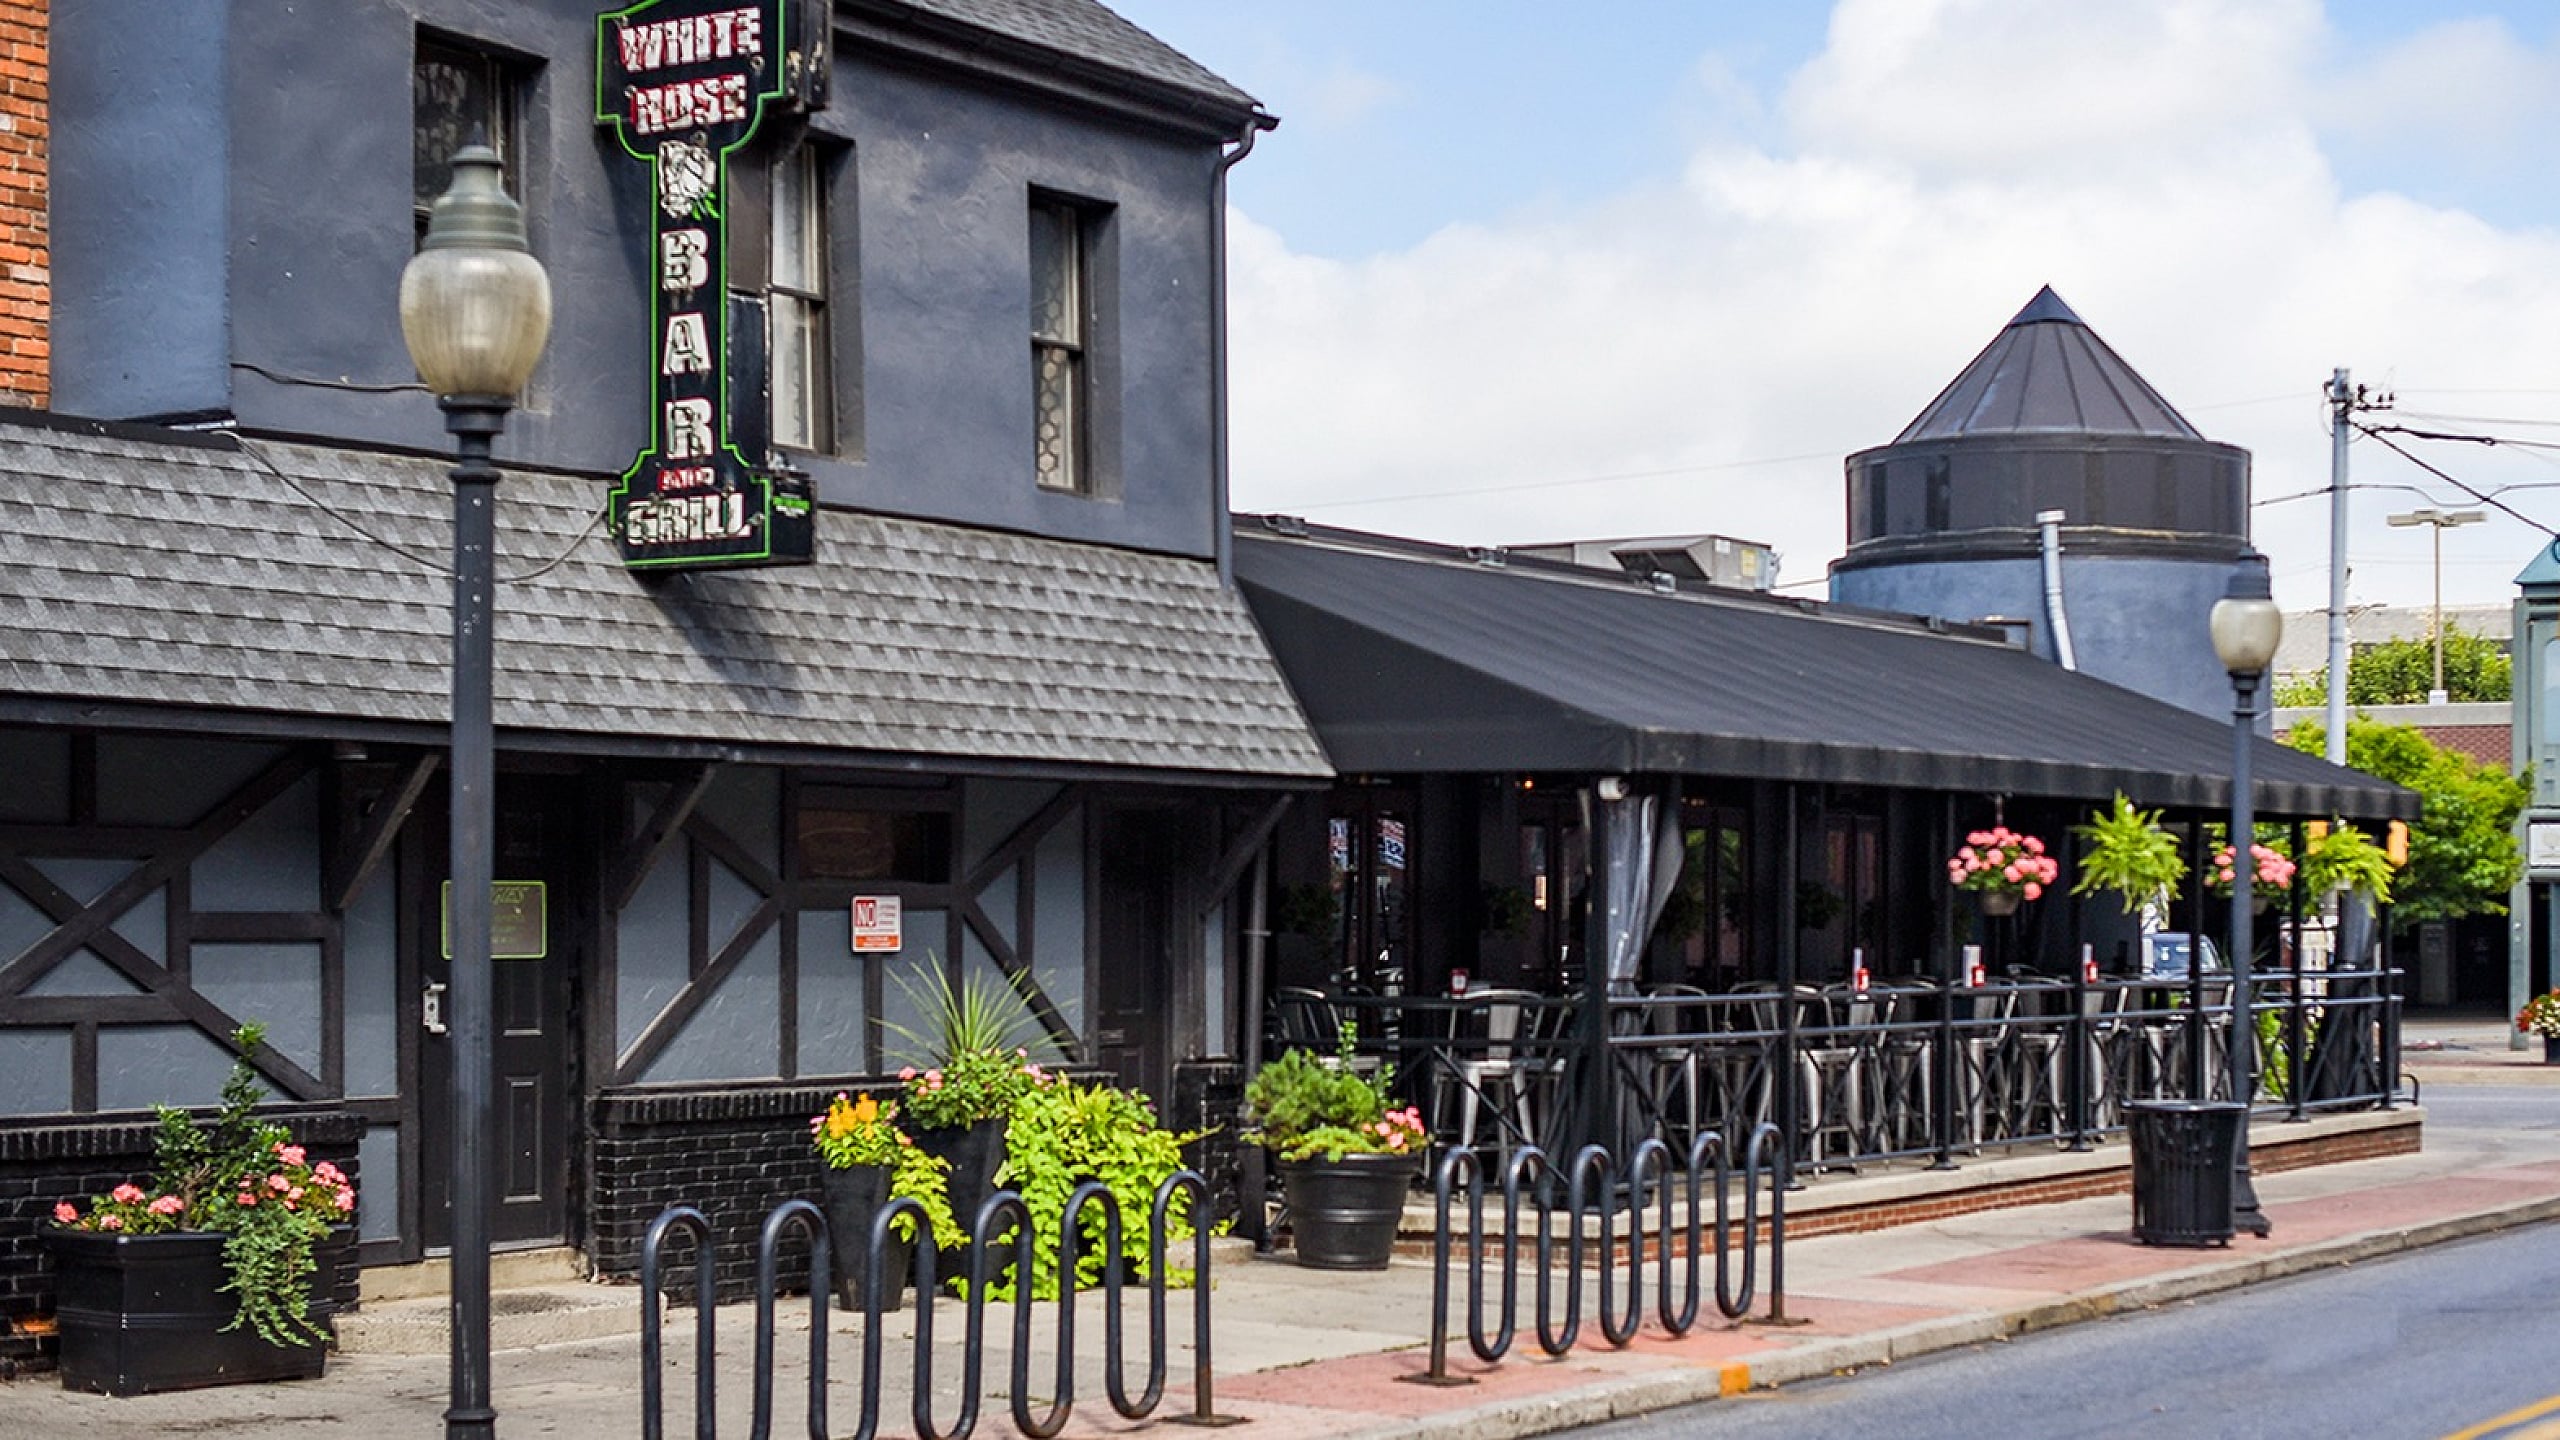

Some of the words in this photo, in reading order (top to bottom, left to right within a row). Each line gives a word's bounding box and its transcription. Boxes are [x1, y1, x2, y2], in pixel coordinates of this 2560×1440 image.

[620, 7, 762, 71] WHITE
[631, 75, 748, 134] ROSE
[661, 228, 714, 459] BAR
[626, 493, 753, 545] GRILL
